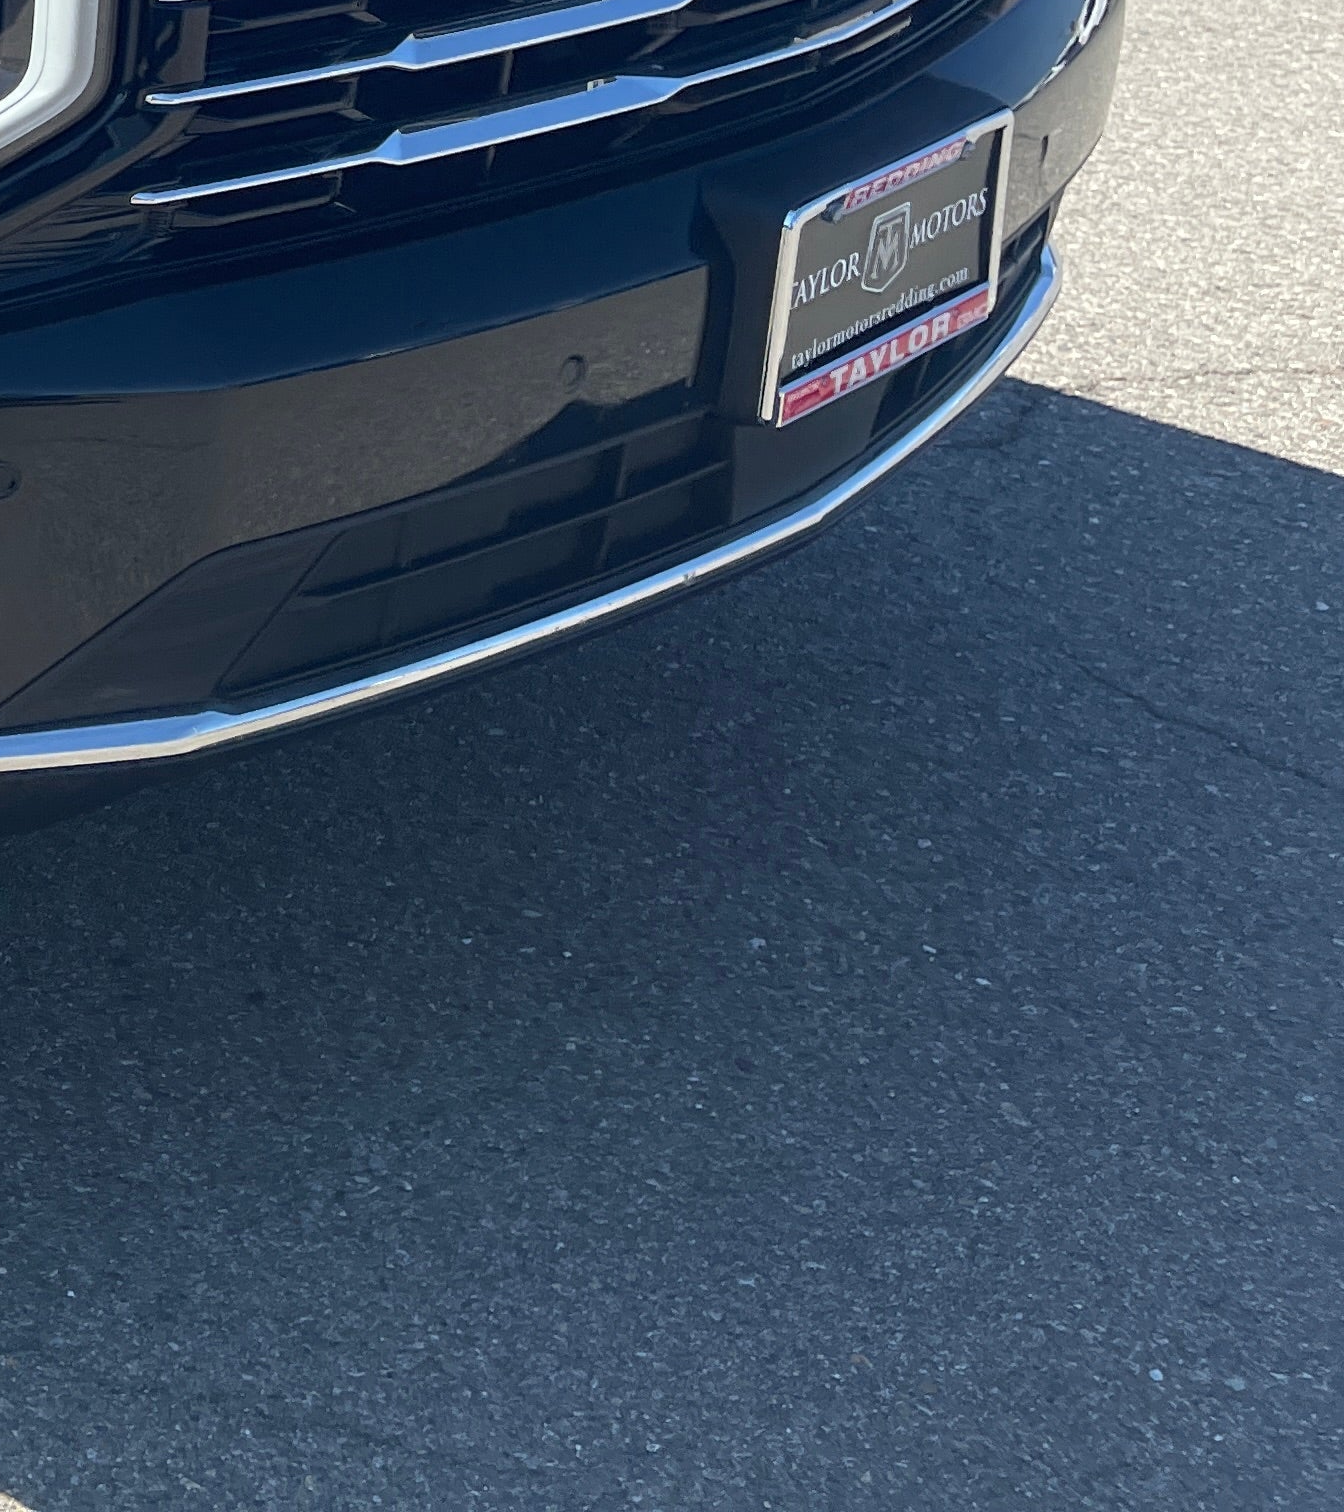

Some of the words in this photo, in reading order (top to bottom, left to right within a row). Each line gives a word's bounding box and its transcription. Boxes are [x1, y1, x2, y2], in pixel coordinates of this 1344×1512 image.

[909, 187, 989, 249] MOTORS
[791, 267, 969, 370] taylormotorsredding.com
[829, 311, 951, 396] TAYLOR
